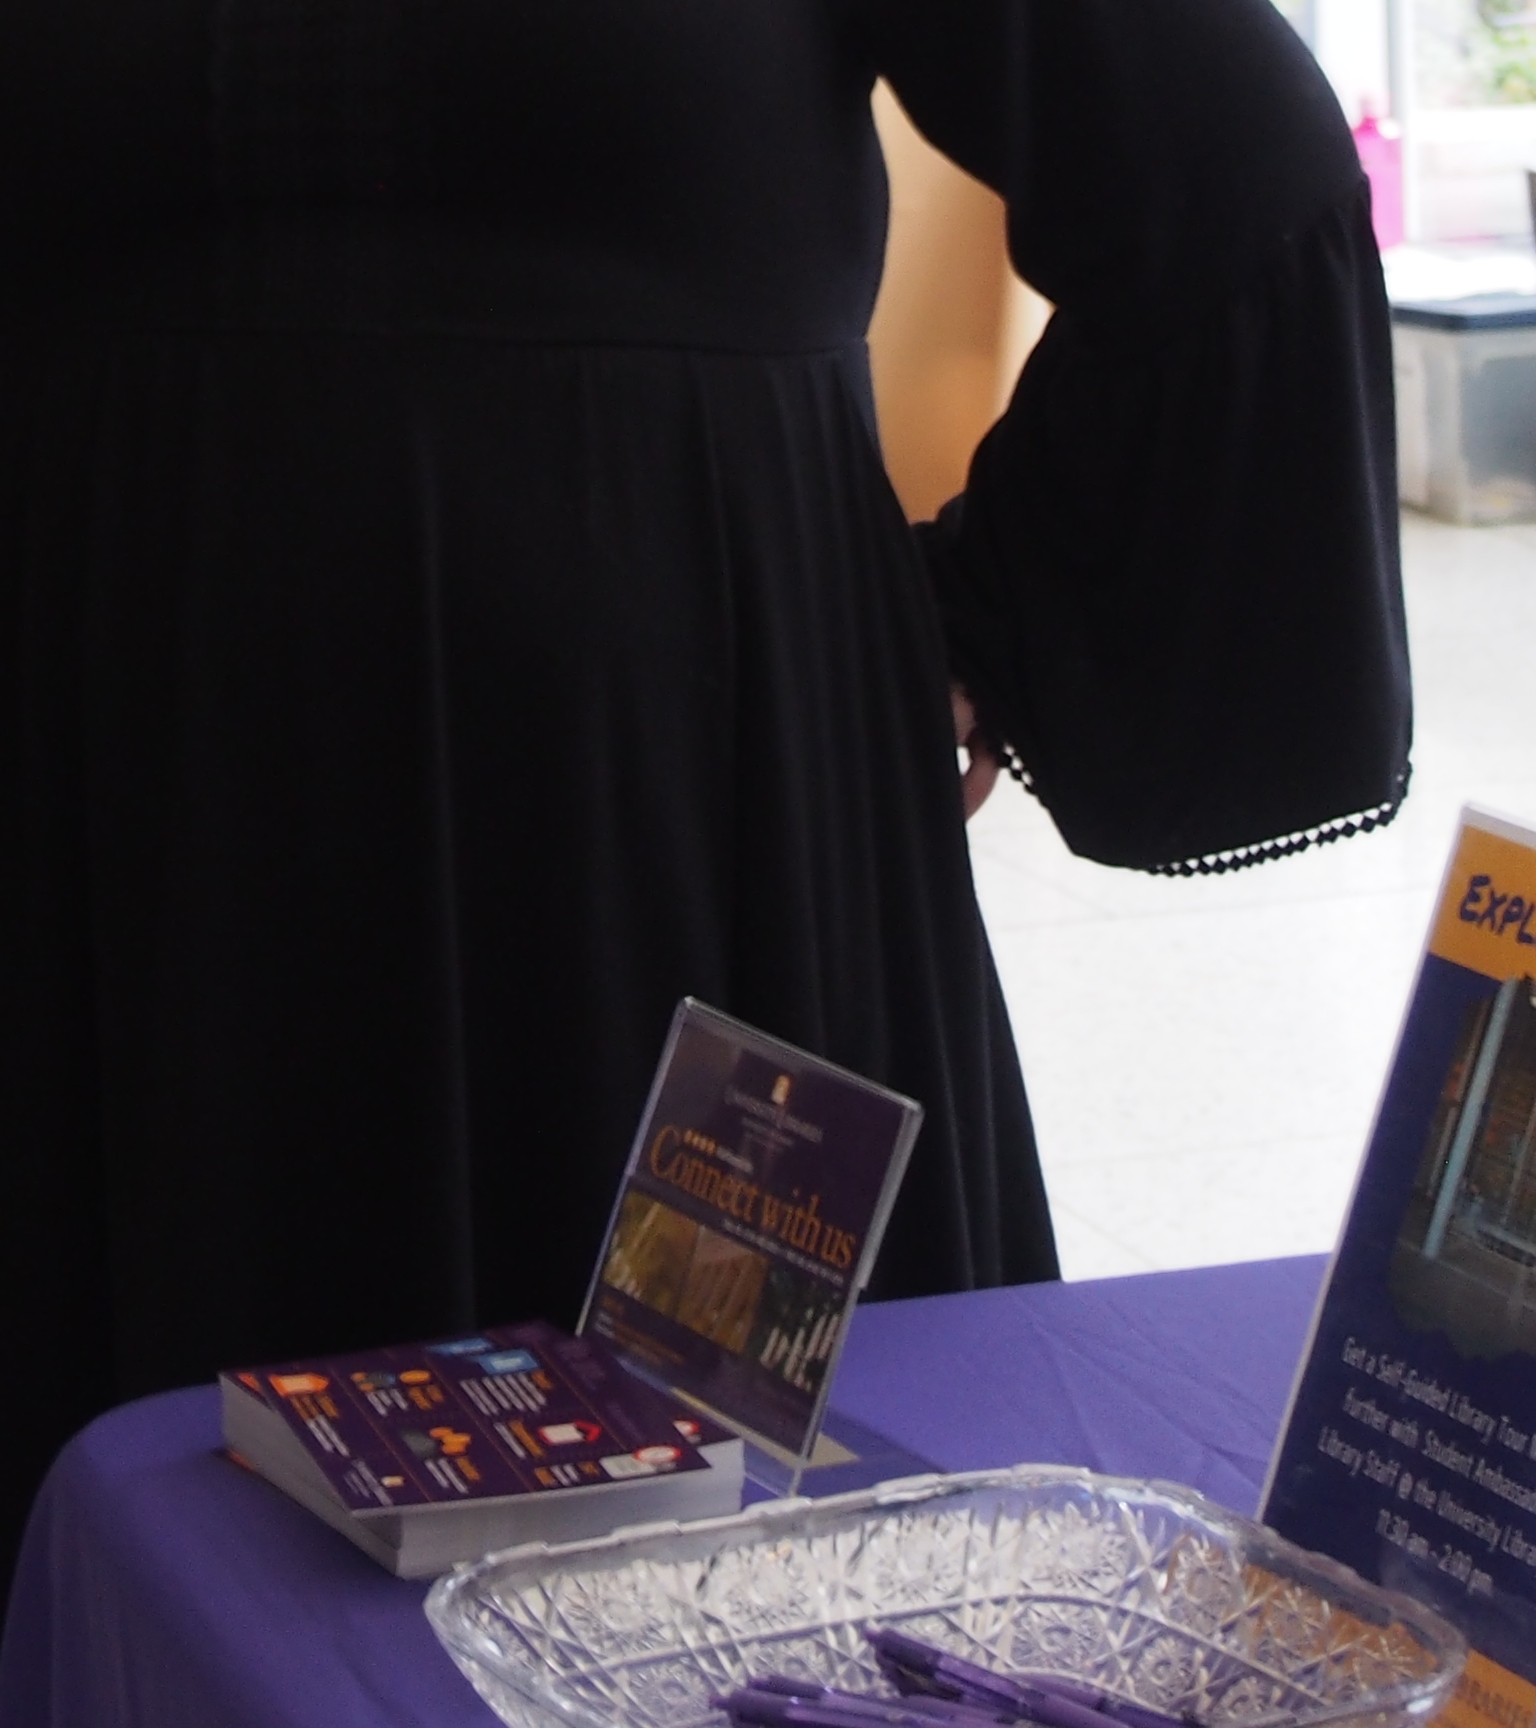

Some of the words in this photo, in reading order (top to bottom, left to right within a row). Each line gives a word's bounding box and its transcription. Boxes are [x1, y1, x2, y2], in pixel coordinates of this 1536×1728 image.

[651, 1125, 758, 1222] Connect
[761, 1188, 821, 1253] with
[821, 1225, 856, 1269] us
[1342, 1336, 1367, 1368] Get
[1448, 1392, 1497, 1445] Library
[1498, 1416, 1528, 1453] Tour
[1422, 1429, 1474, 1478] Student
[1318, 1425, 1363, 1476] Library
[1364, 1449, 1401, 1488] Staff
[1414, 1477, 1437, 1511] the
[1436, 1490, 1501, 1553] University
